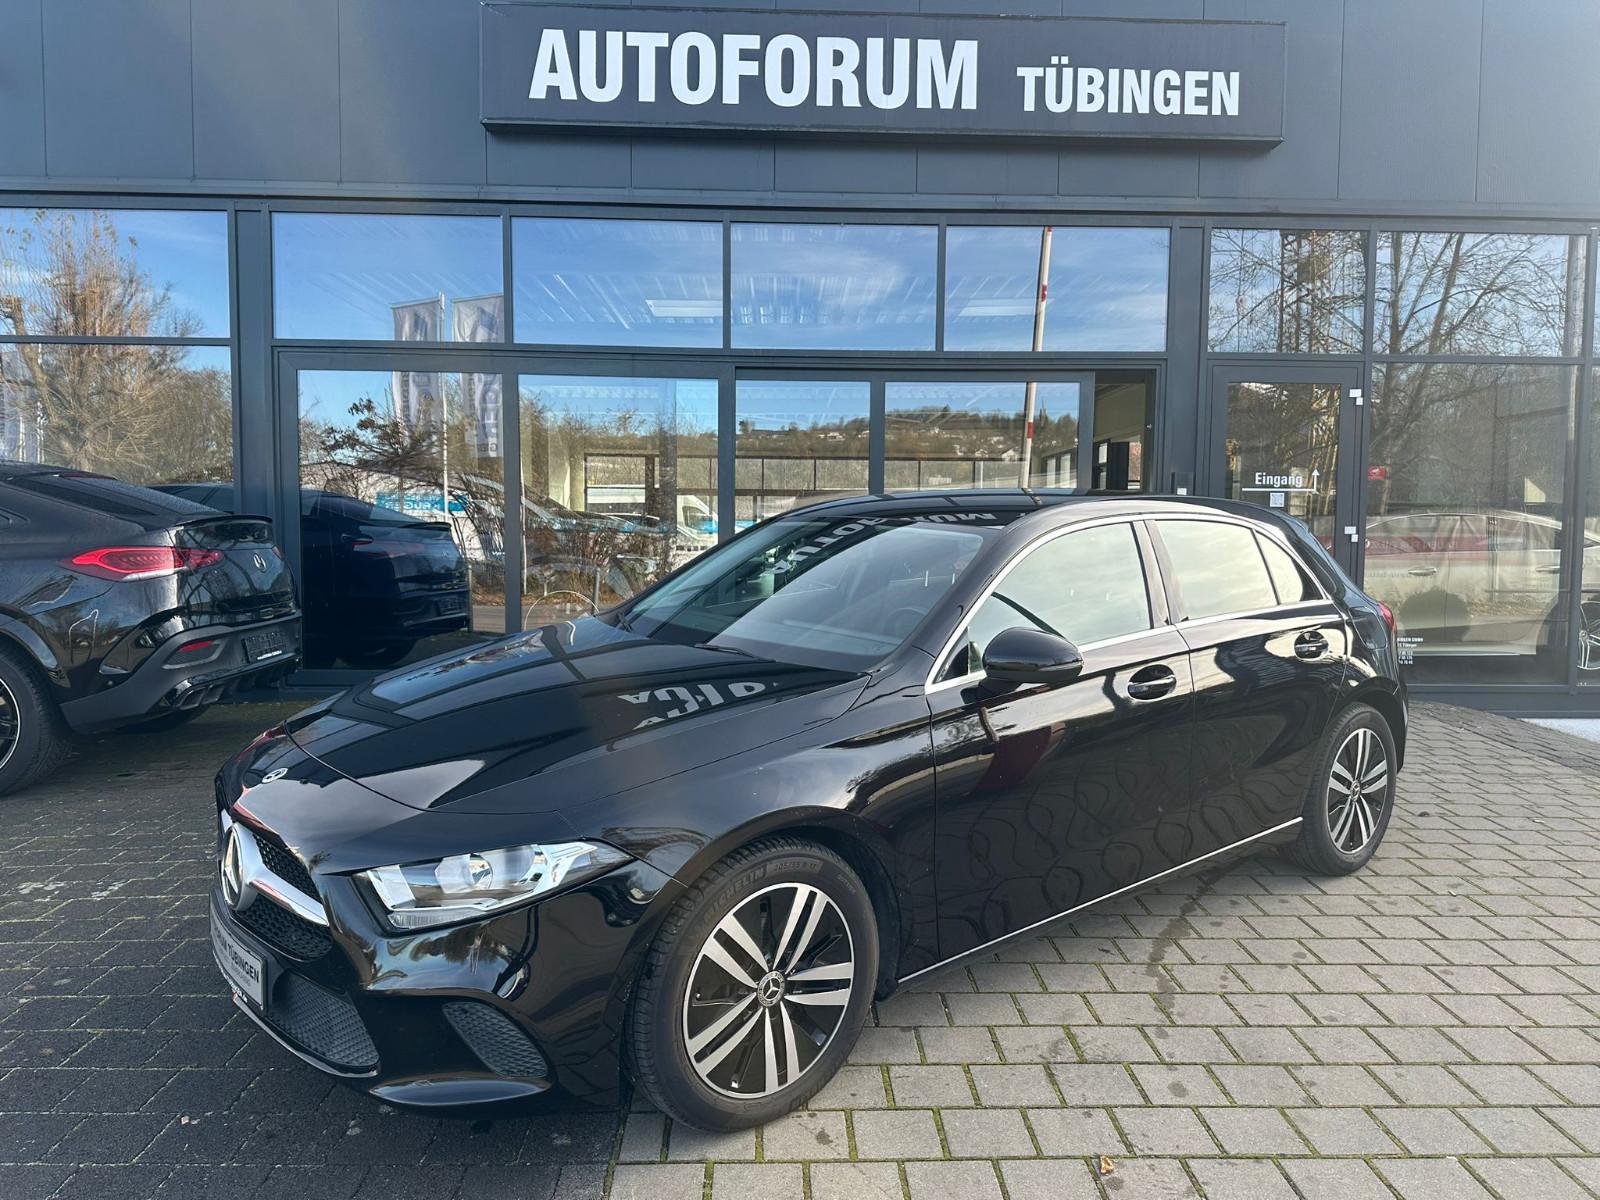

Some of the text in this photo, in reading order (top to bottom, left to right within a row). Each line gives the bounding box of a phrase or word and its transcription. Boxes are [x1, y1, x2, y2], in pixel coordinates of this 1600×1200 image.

[528, 28, 1240, 117] AUTOFORUM TÜBINGEN
[1255, 471, 1303, 488] Eingang
[703, 866, 766, 922] MICHELIN
[227, 943, 259, 983] TÜBINGEN
